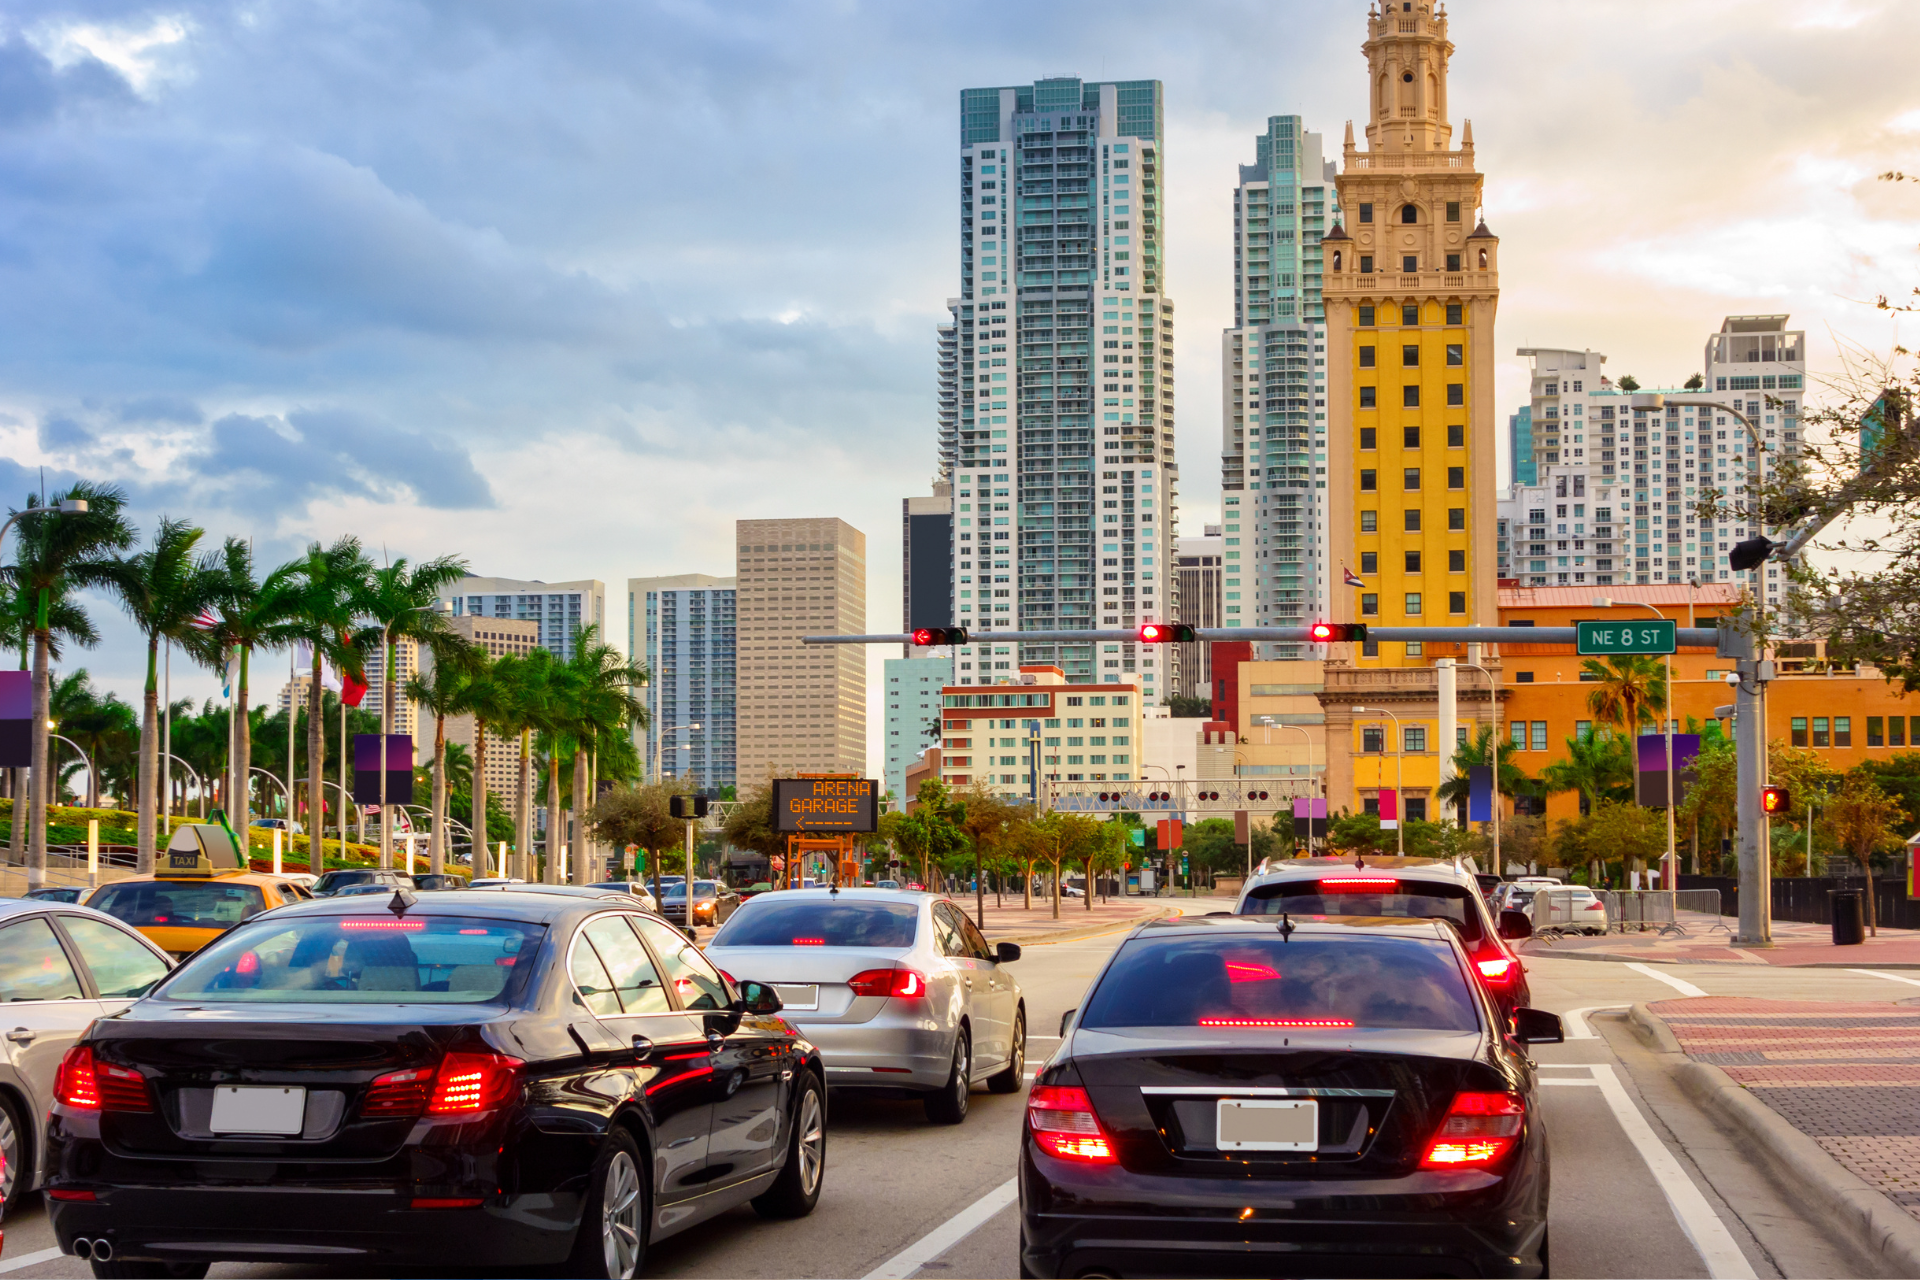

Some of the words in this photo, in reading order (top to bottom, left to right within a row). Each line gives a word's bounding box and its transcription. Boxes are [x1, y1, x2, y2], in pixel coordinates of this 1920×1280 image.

[1592, 630, 1614, 645] NE
[1621, 628, 1633, 646] 8
[1640, 629, 1660, 645] ST
[813, 781, 871, 796] ARENA
[790, 798, 859, 813] GARAGE
[173, 856, 195, 866] TAXI
